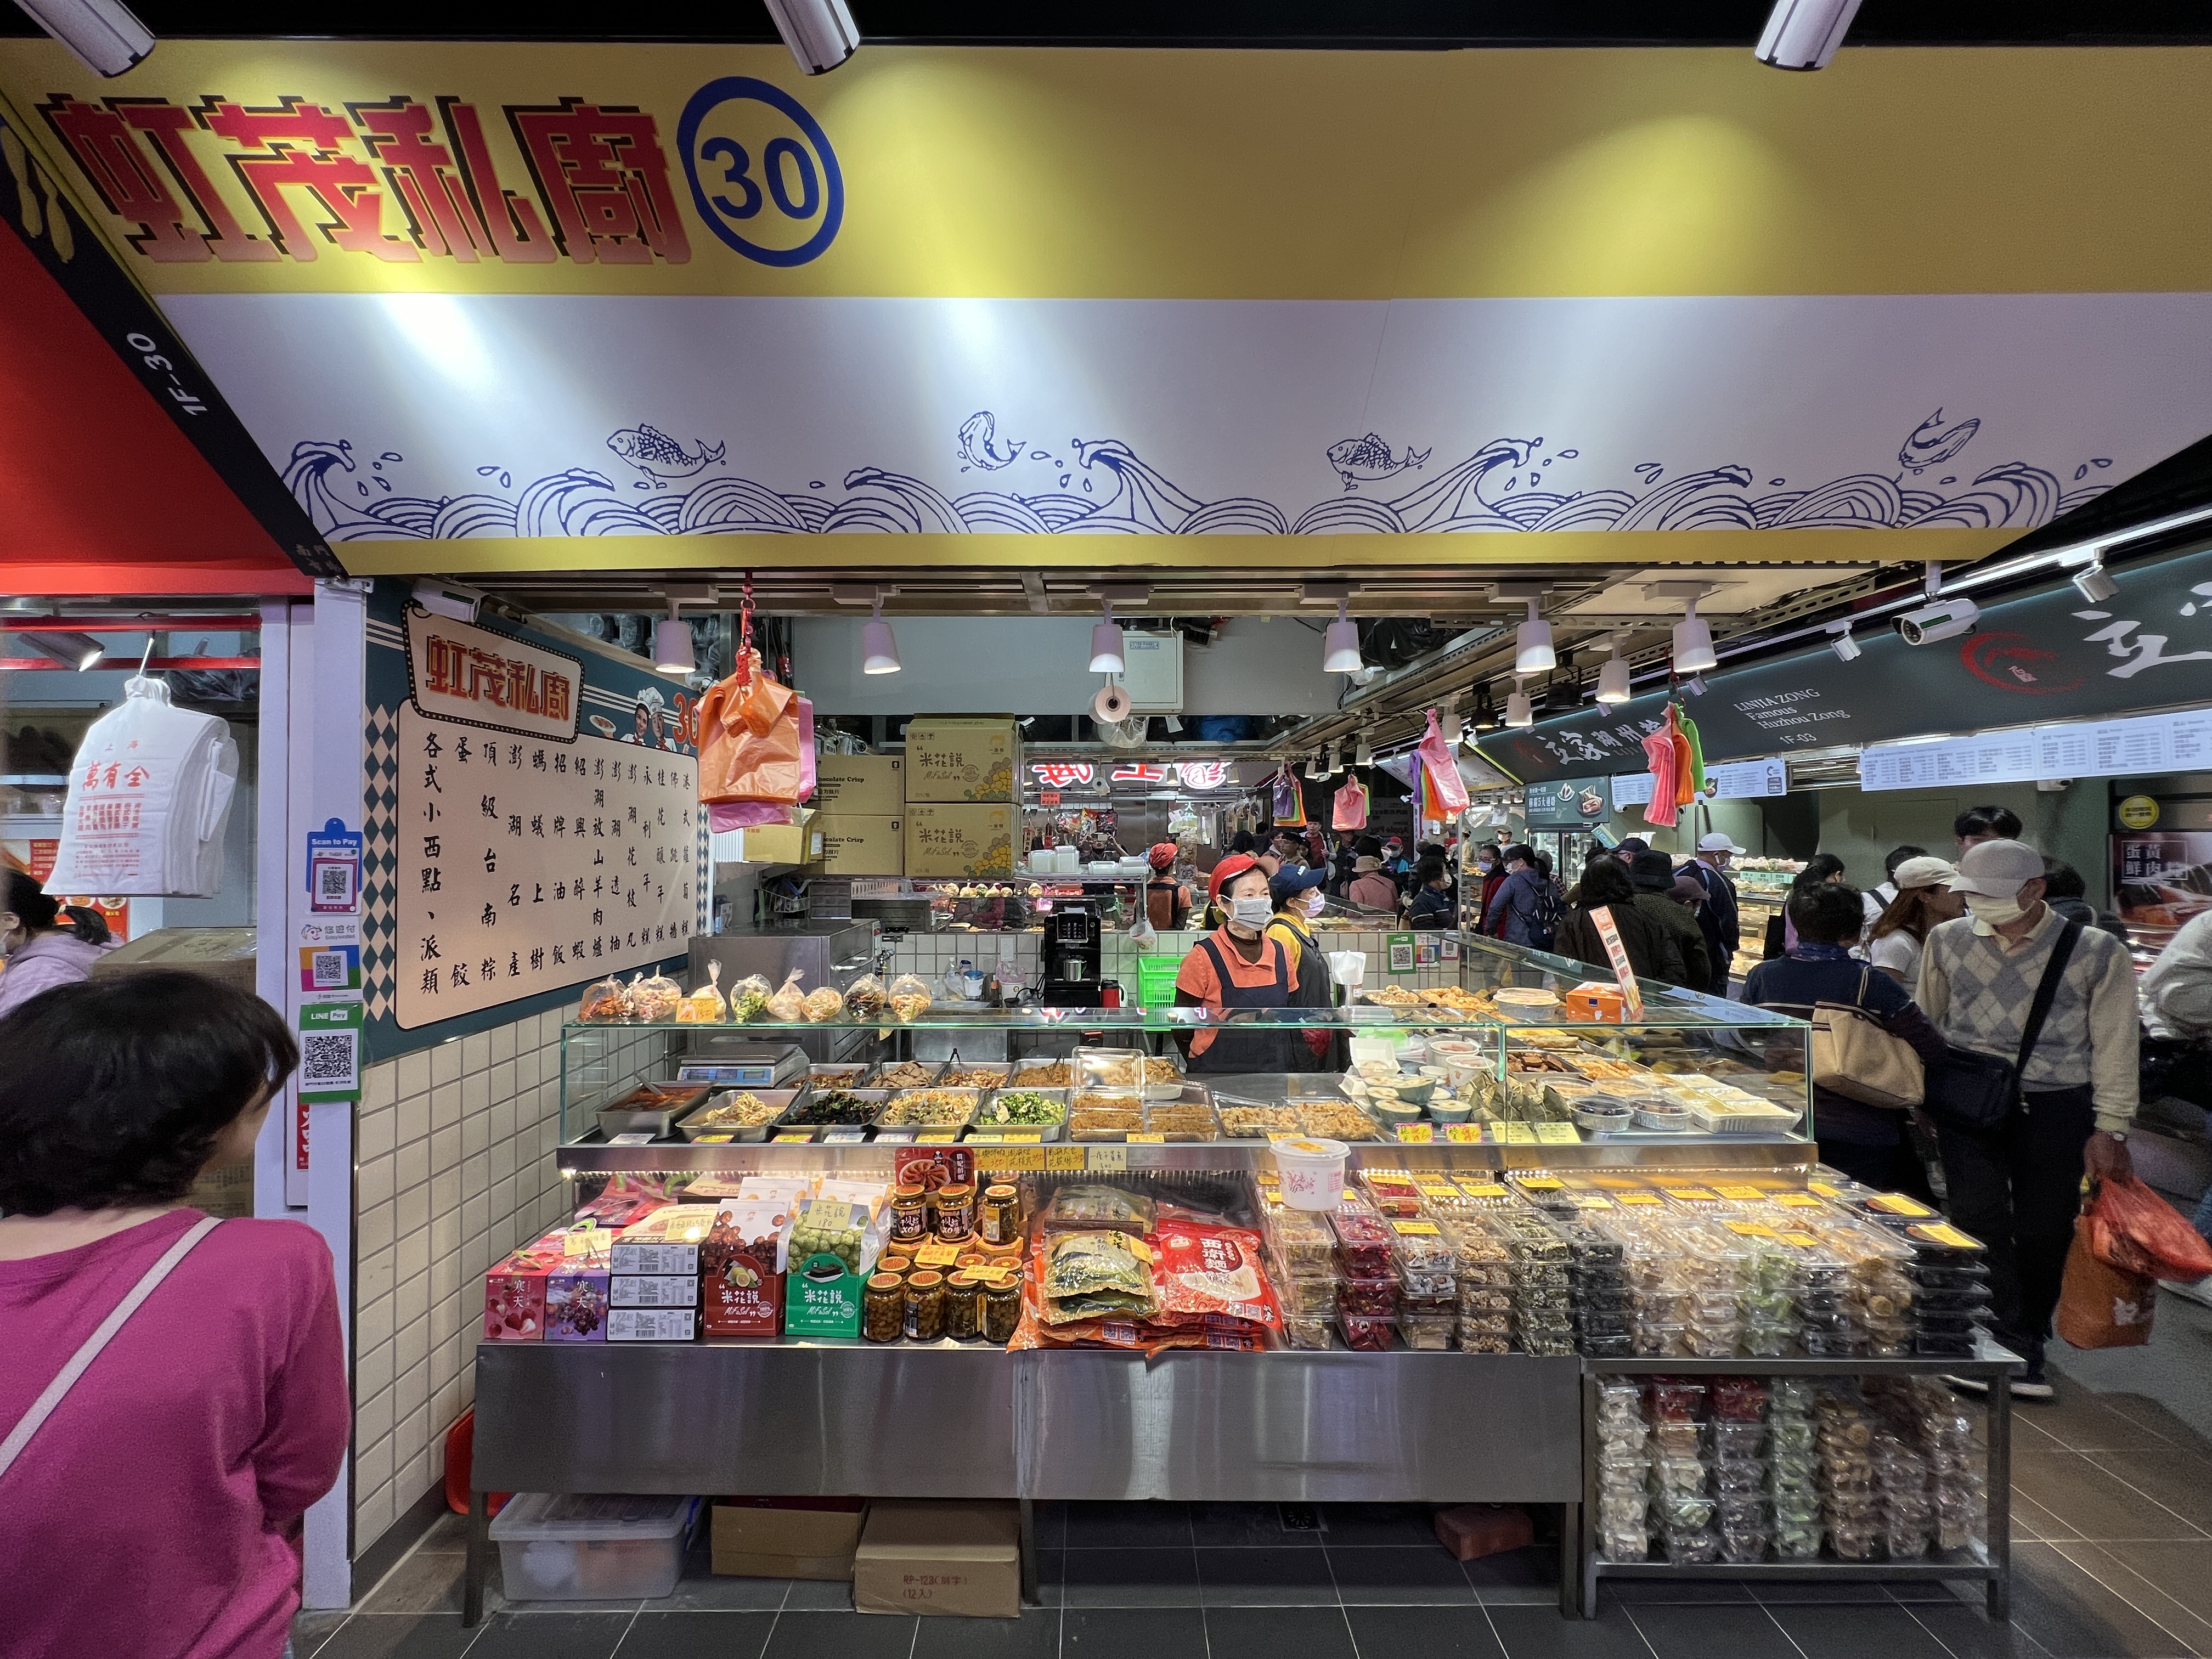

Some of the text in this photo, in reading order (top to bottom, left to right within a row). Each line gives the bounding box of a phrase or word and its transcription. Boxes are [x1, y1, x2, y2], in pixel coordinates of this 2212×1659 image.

[38, 94, 691, 263] 虹茂私廚
[699, 137, 819, 219] 30
[127, 332, 207, 415] 1F-30
[426, 634, 570, 722] 虹茂私廚
[1733, 689, 1820, 712] LINJIA ZONG
[1745, 707, 1798, 720] Famous
[1757, 710, 1851, 729] Huzhou Zong
[1780, 733, 1817, 744] 1F-03
[82, 760, 150, 791] 萬有全
[551, 753, 567, 965] 招牌油飯
[1032, 1153, 1045, 1163] 350
[818, 1218, 832, 1227] 180
[512, 1279, 526, 1308] 寒天
[576, 1280, 589, 1309] 寒天
